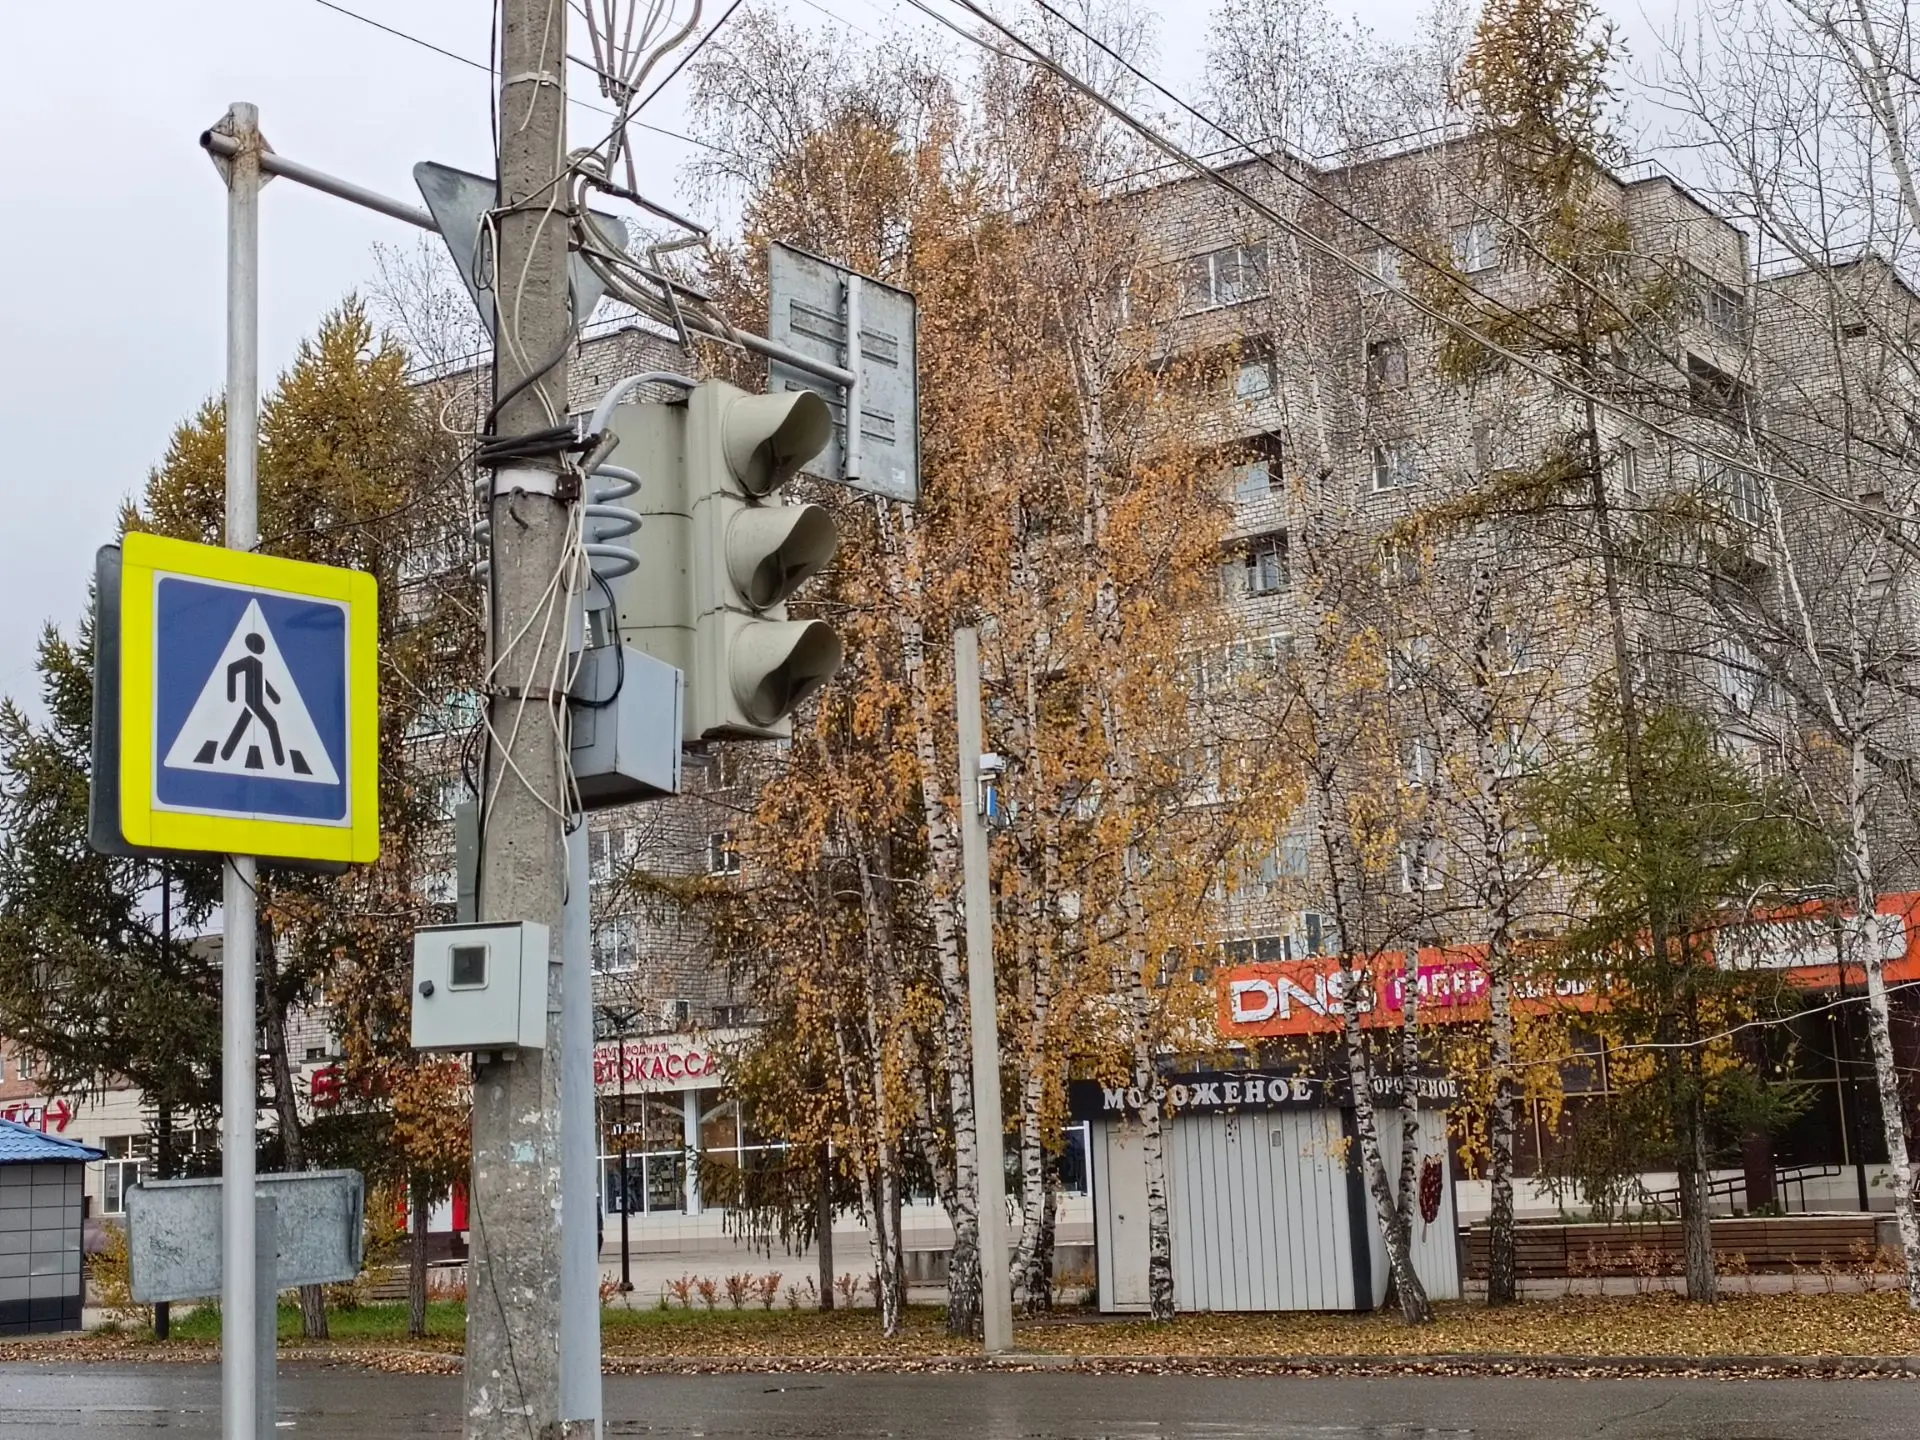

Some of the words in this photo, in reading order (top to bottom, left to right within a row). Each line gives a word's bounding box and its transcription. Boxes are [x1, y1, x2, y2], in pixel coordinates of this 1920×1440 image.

[1230, 969, 1377, 1023] DNS
[1394, 970, 1485, 999] ГИПЕР
[1103, 1079, 1313, 1110] МОРОЖЕНОЕ
[1373, 1078, 1458, 1099] ОРОЕНОЕ
